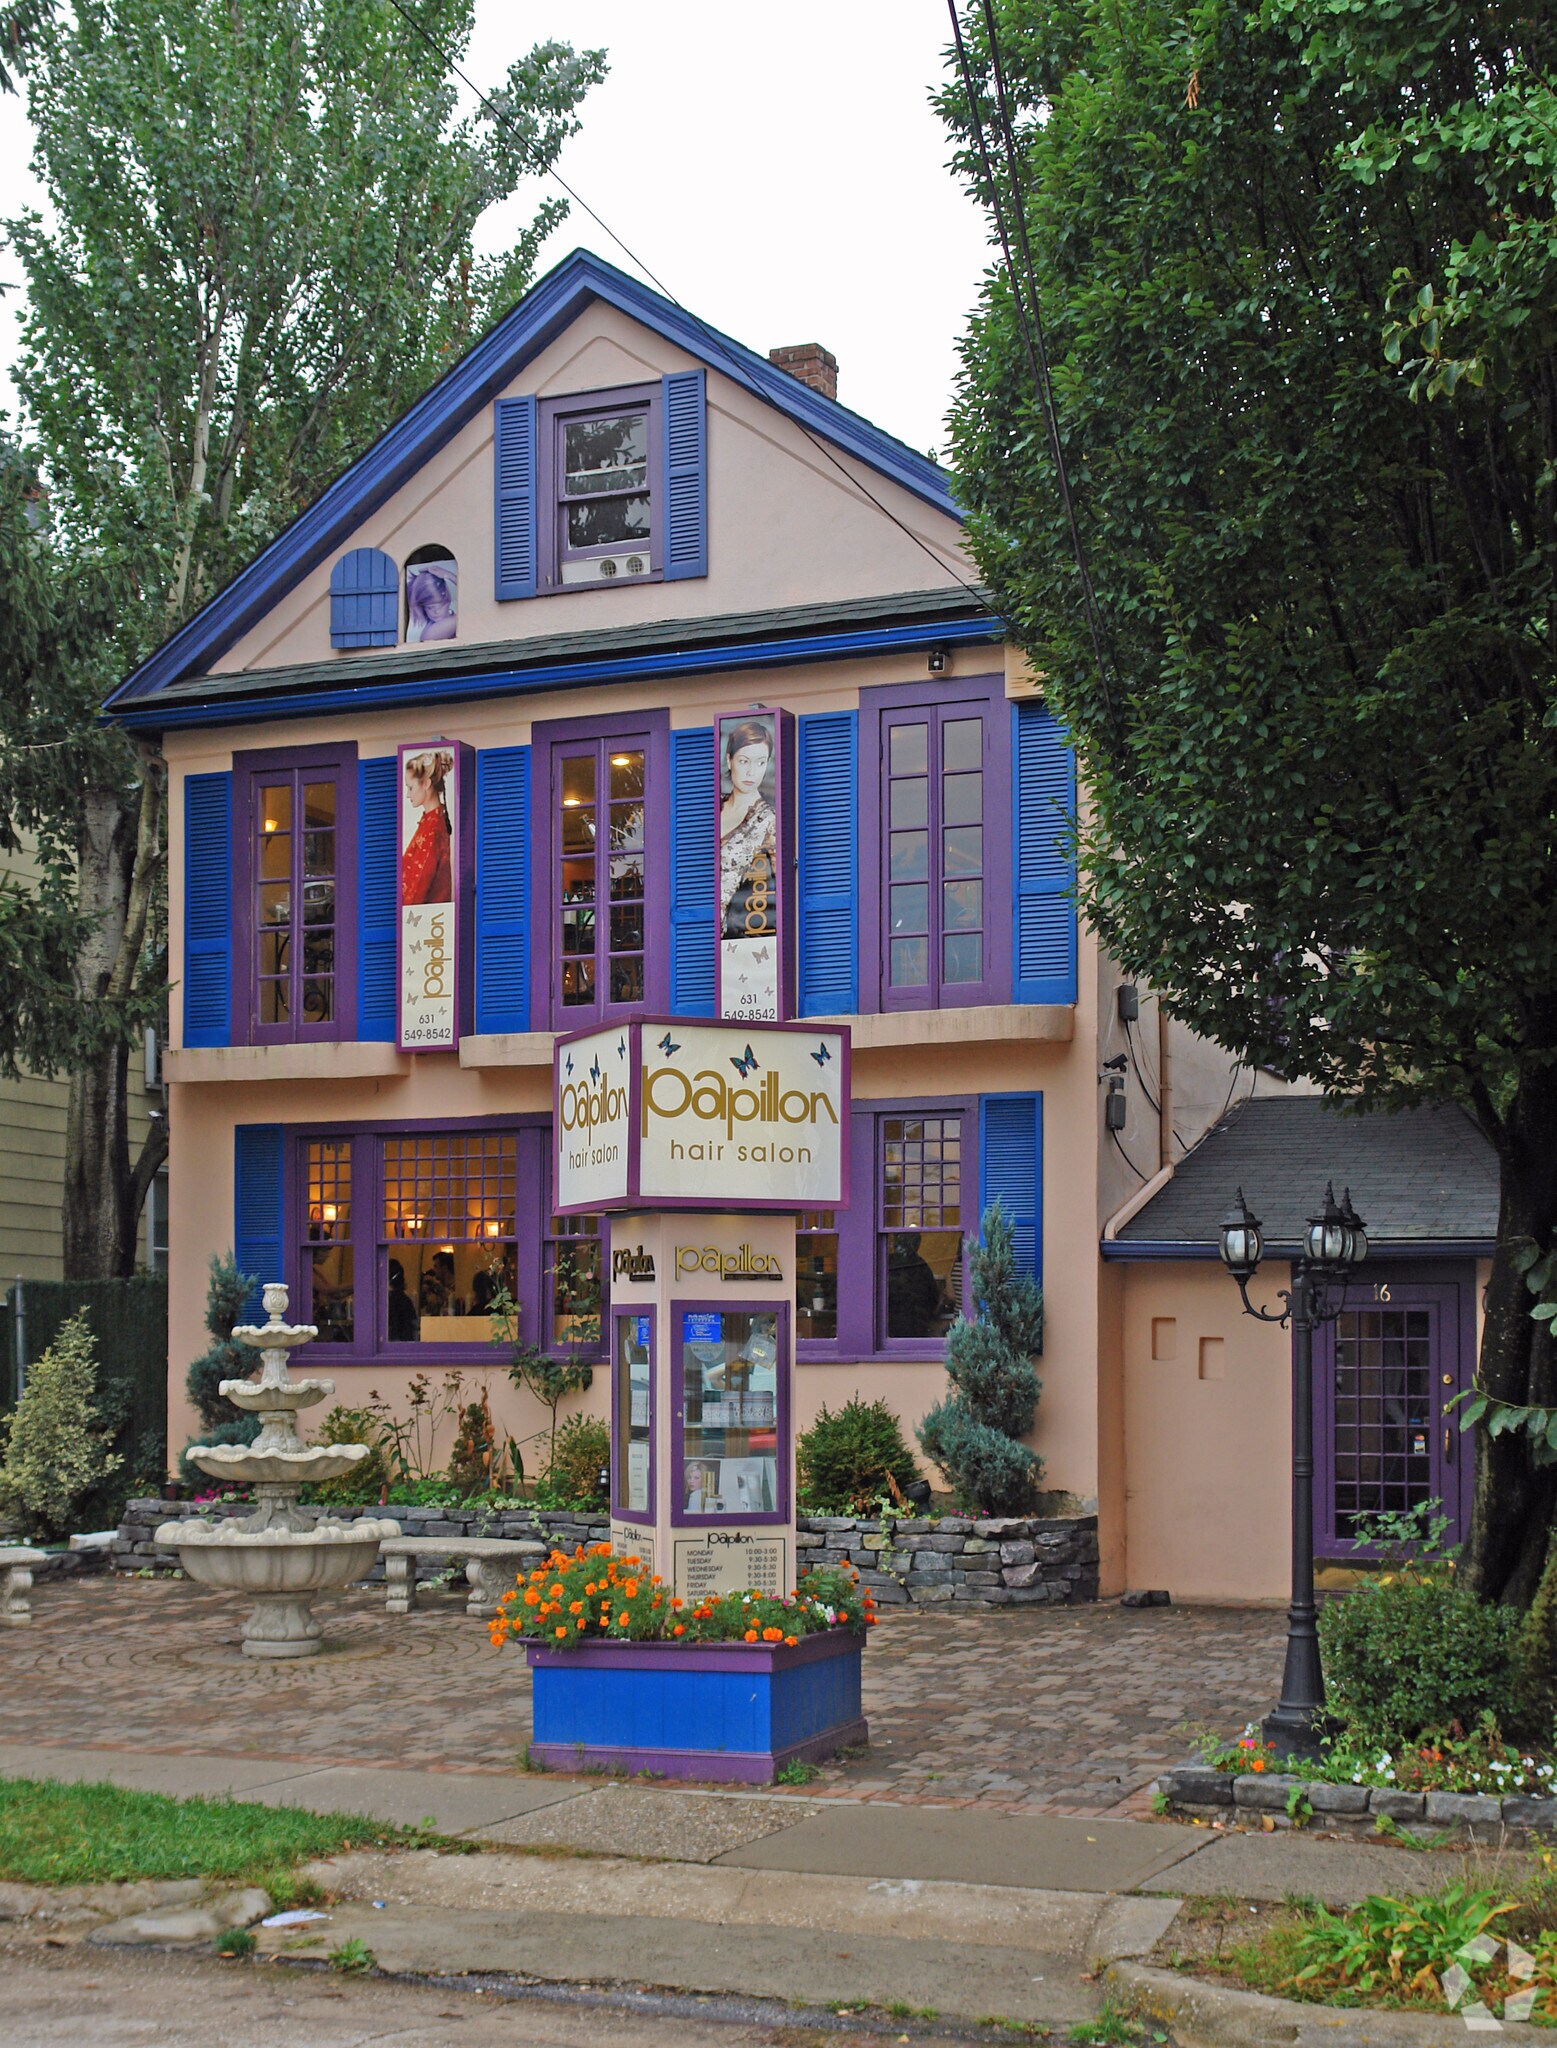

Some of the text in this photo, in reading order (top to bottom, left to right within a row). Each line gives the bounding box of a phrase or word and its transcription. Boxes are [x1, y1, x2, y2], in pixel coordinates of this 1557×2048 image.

[423, 912, 452, 999] papillon
[740, 994, 758, 1005] 631
[418, 1014, 435, 1024] 631
[724, 1008, 776, 1021] 549-8542
[404, 1028, 451, 1040] 549-8542
[560, 1072, 629, 1152] papillon
[642, 1065, 839, 1141] papillon
[569, 1143, 618, 1170] hair salon
[671, 1139, 812, 1163] hair salon
[675, 1244, 782, 1282] papillon
[1373, 1283, 1391, 1302] 16
